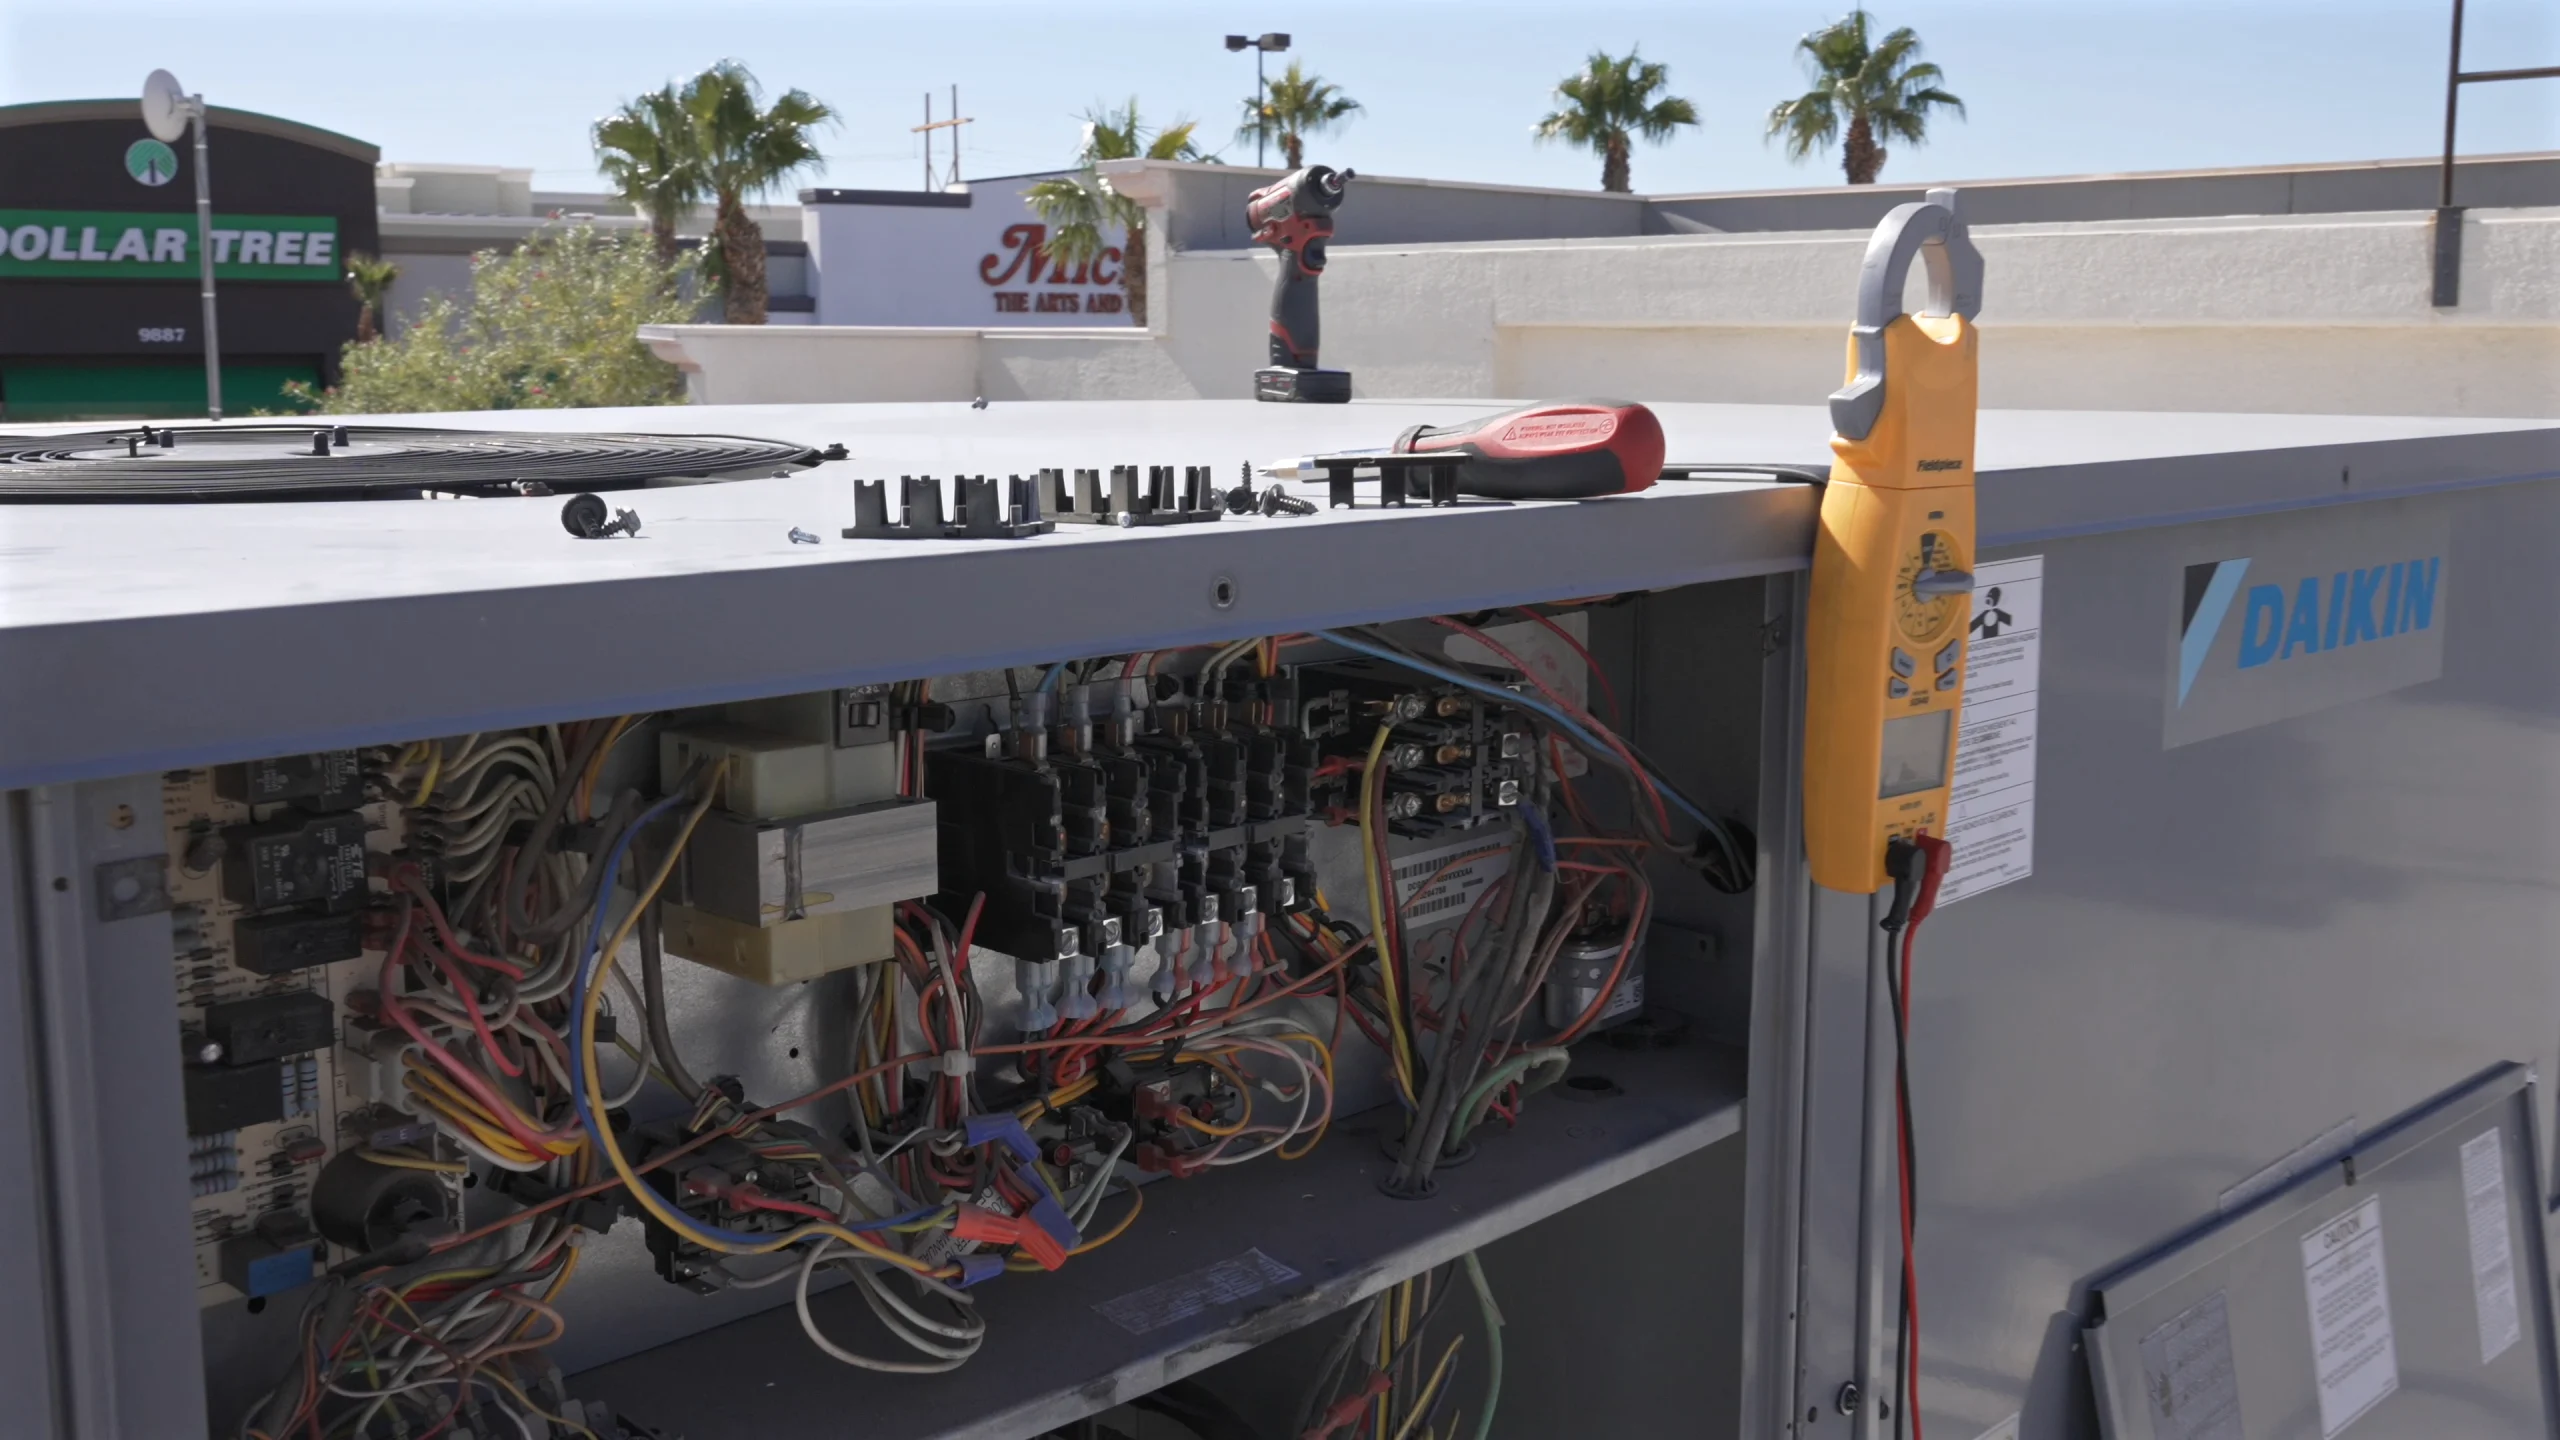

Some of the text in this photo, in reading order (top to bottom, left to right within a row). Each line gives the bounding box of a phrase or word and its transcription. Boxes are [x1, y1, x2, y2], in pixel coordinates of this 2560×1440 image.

[210, 229, 335, 265] TREE
[993, 291, 1123, 313] THE ARTS AND
[138, 327, 186, 342] 9887
[2237, 556, 2440, 669] DAIKIN
